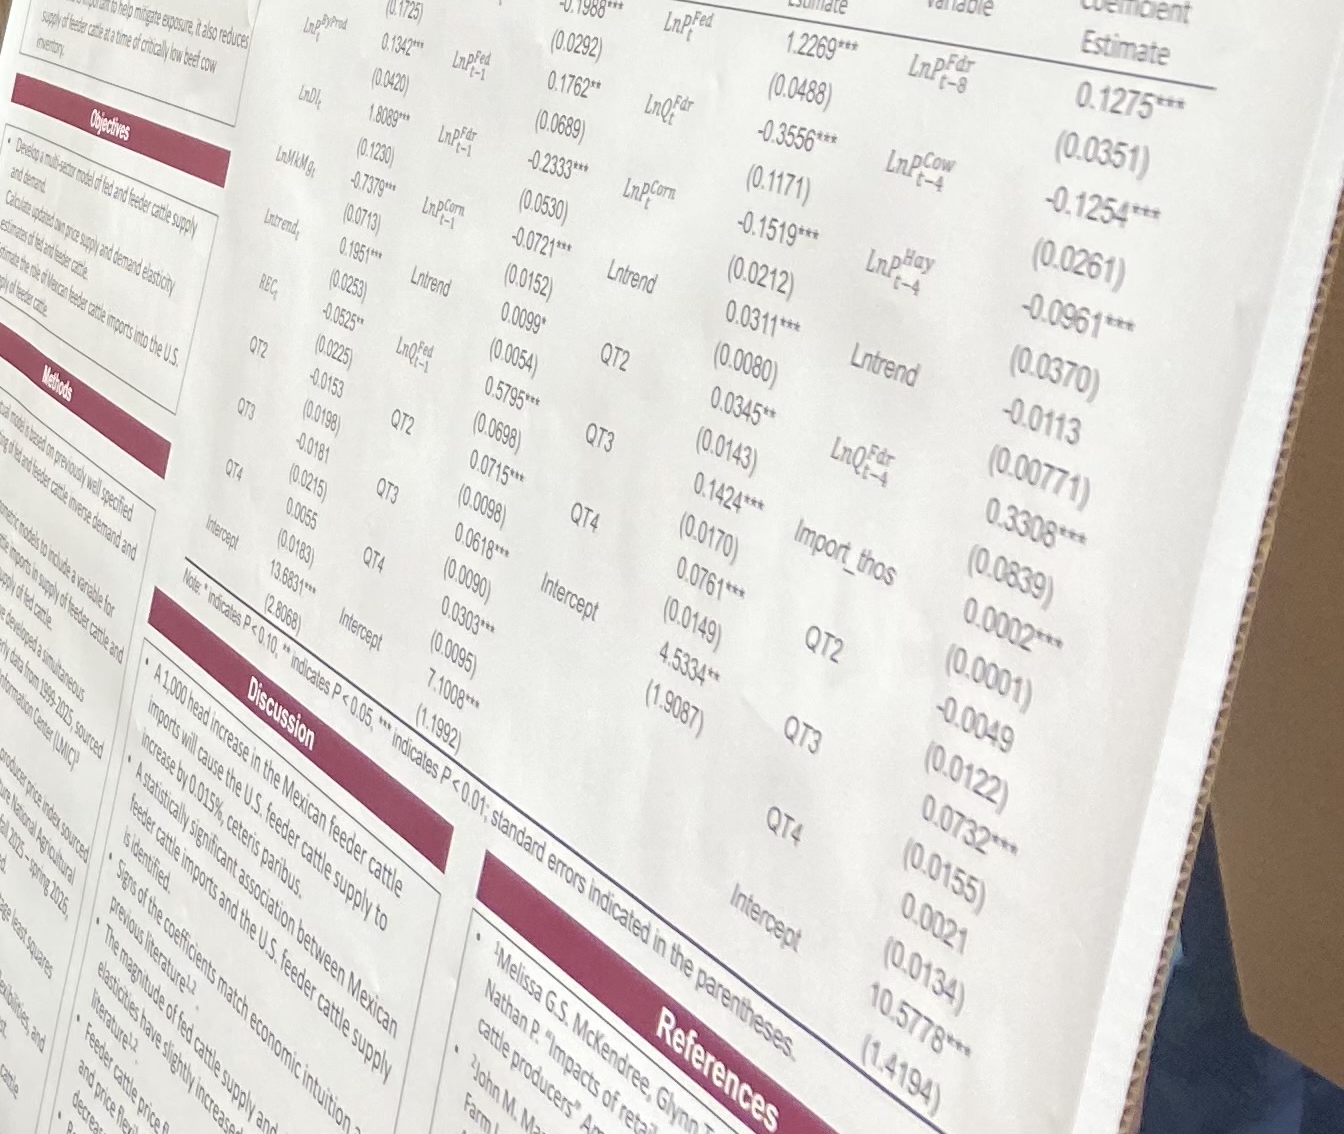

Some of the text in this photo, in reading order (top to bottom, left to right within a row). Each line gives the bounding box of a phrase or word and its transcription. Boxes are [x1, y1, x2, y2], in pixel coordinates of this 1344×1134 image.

[550, 29, 604, 64] (0.0292)
[1080, 29, 1172, 67] Estimate
[768, 71, 833, 112] (0.0488)
[89, 108, 132, 142] Objectives
[1054, 129, 1151, 182] (0.0351)
[171, 213, 199, 241] supply
[504, 263, 554, 303] (0.0152)
[606, 258, 658, 295] Lntrend
[727, 253, 795, 301] (0.0212)
[1031, 236, 1127, 294] (0.0261)
[600, 342, 631, 373] QT2
[41, 364, 74, 403] Methods
[310, 368, 345, 400] -0.0153
[390, 408, 415, 436] QT2
[1002, 397, 1083, 447] -0.0113
[570, 502, 602, 533] QT4
[679, 511, 739, 566] (0.0170)
[794, 517, 898, 587] Import_thos
[540, 570, 601, 623] Intercept
[805, 624, 845, 665] QT2
[247, 674, 317, 752] Discussion
[645, 678, 705, 739] (1.9087)
[936, 695, 1015, 755] -0.0049
[162, 668, 405, 900] 1,000 head increase in the Mexican feeder cattle
[147, 694, 389, 933] imports will cause the U.S. feeder cattle supply to
[491, 807, 797, 1063] standard errors indicated in the parentheses.
[883, 935, 966, 1018] (0.0134)
[655, 1005, 782, 1134] References
[861, 1033, 942, 1119] (1.4194)
